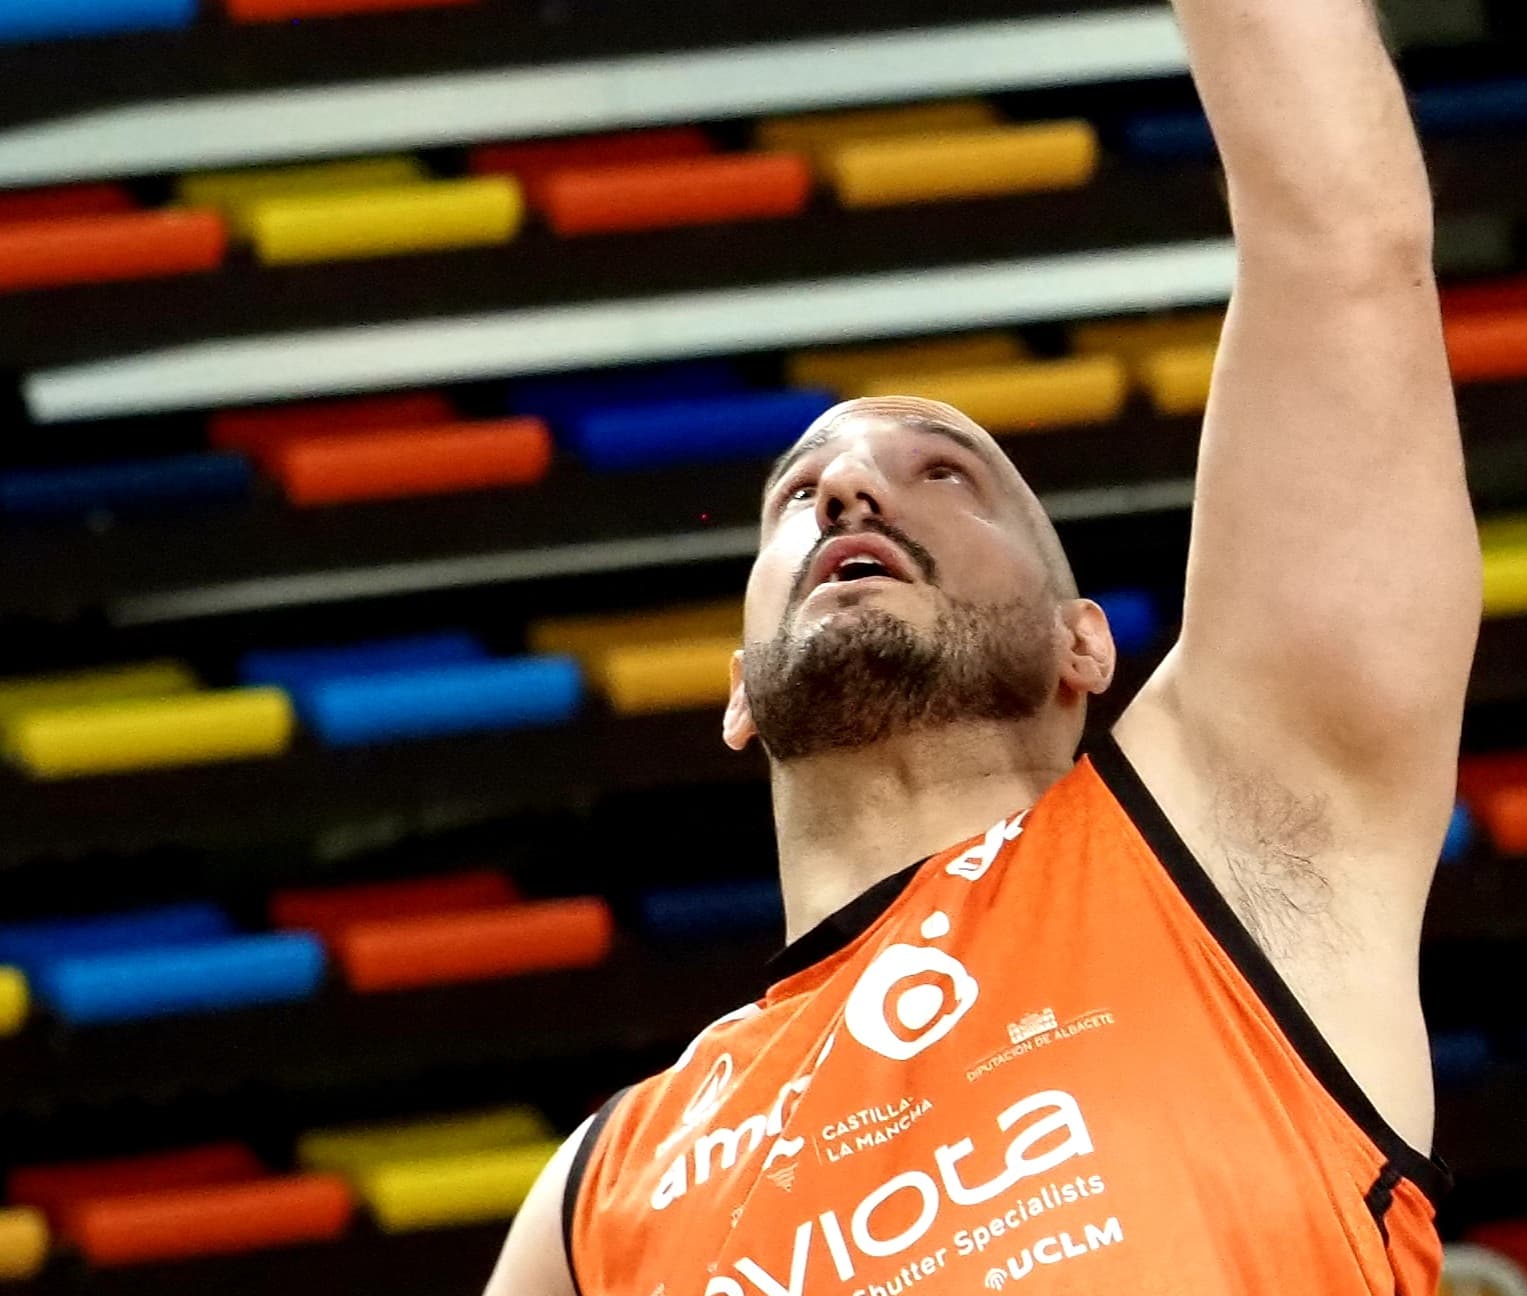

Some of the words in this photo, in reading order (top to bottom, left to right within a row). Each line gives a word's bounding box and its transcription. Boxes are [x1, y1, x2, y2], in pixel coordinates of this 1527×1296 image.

[826, 1144, 854, 1163] LA
[856, 1098, 934, 1151] MANCHA
[953, 1173, 1106, 1257] Specialists
[1006, 1215, 1124, 1281] UCLM
